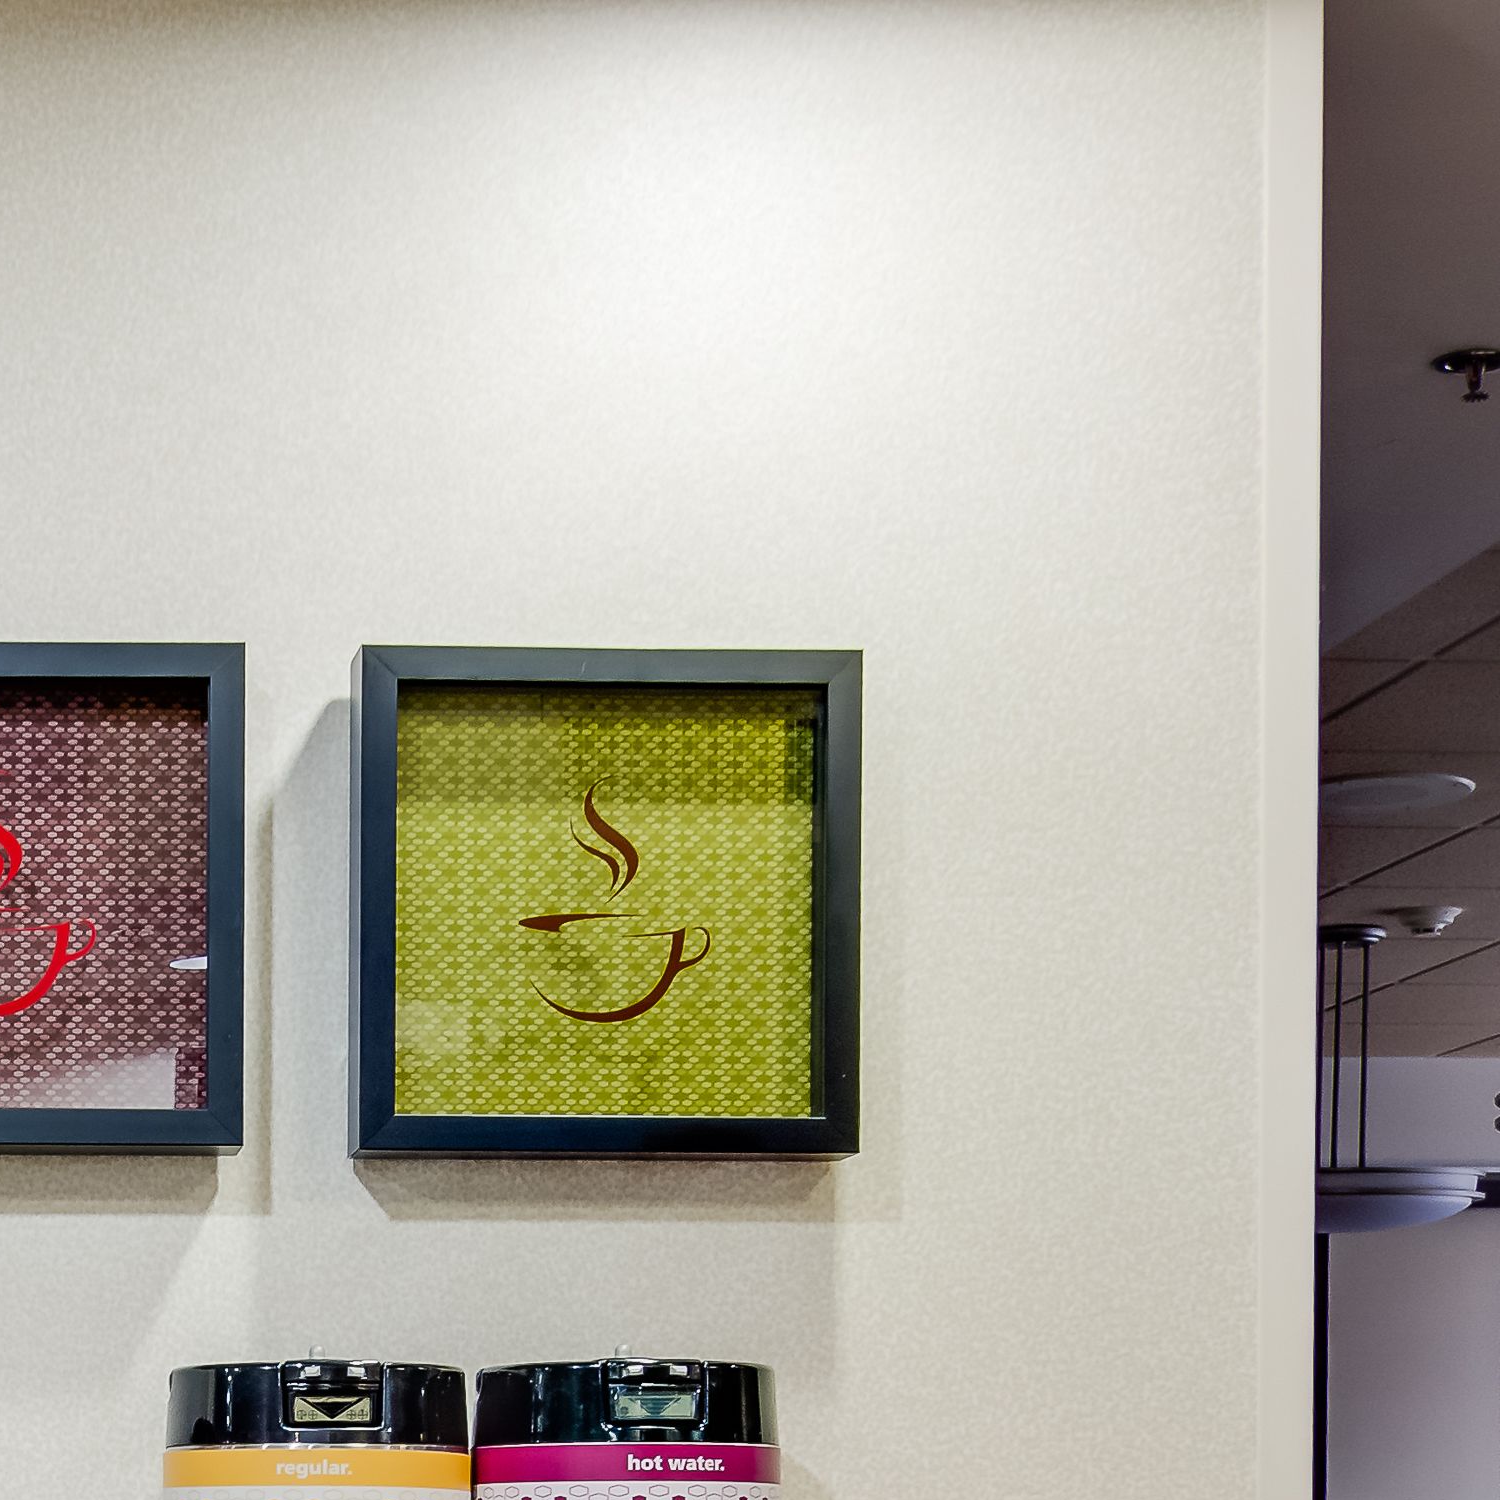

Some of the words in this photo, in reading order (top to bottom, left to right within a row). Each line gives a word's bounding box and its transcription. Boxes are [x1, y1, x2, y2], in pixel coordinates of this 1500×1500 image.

[276, 1459, 352, 1479] regular.
[627, 1454, 663, 1471] hot
[668, 1456, 725, 1471] water.
